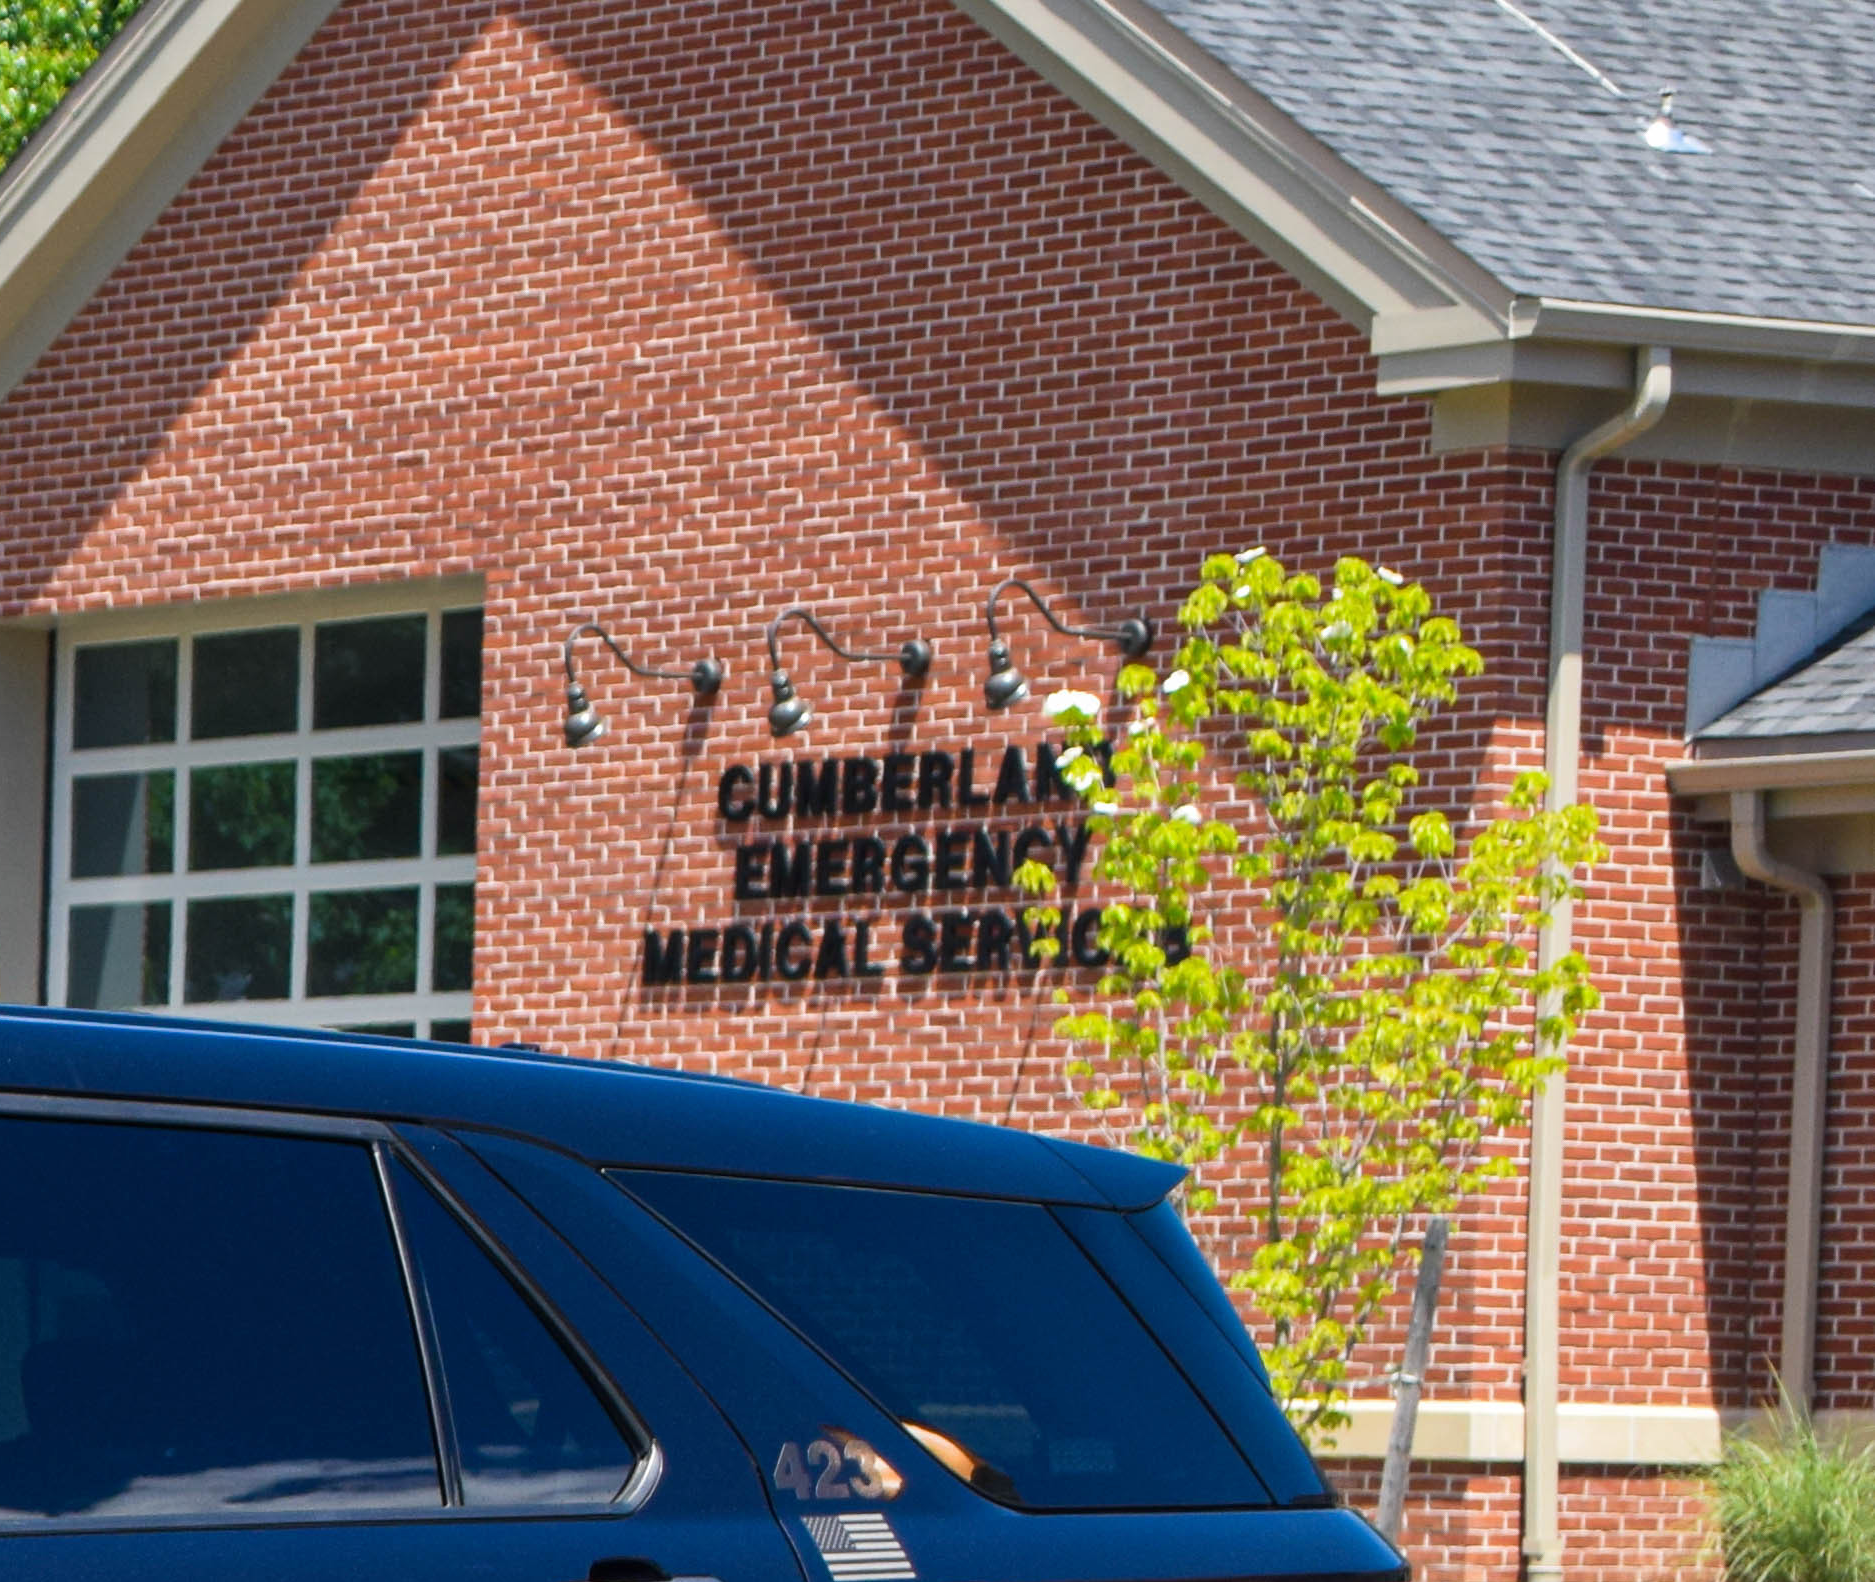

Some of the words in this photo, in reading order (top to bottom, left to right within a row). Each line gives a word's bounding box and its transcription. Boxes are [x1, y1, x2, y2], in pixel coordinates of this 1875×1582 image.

[735, 820, 1091, 899] EMERGENCY
[642, 919, 883, 985] MEDICAL
[902, 904, 1192, 974] SERVICS
[773, 1439, 888, 1499] 423
